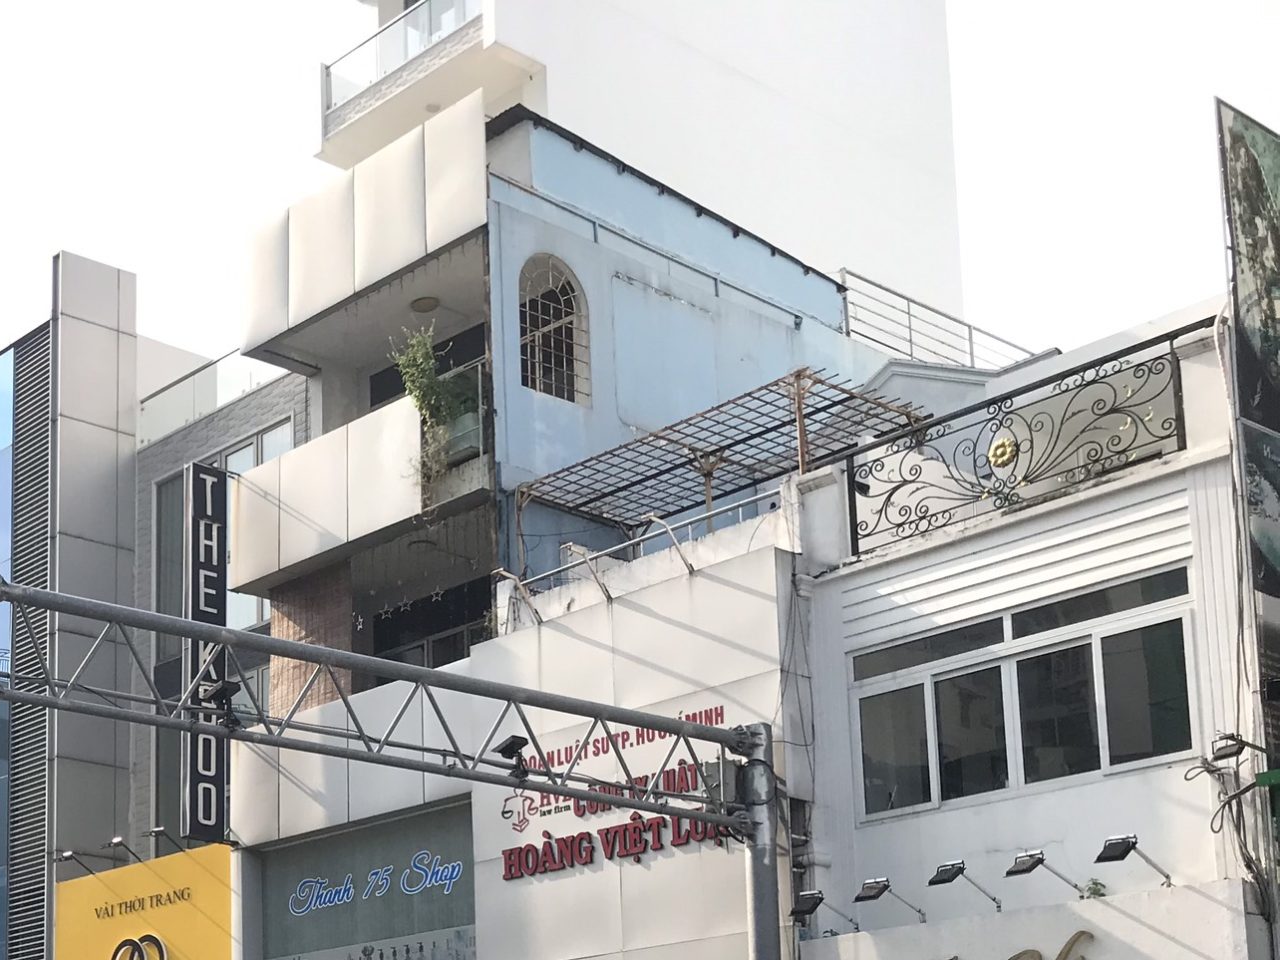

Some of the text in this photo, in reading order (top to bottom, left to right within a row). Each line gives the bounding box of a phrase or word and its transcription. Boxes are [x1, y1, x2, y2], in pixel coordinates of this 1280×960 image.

[198, 473, 218, 614] THE
[539, 805, 571, 818] law firm
[502, 830, 595, 881] HOÀNG
[597, 811, 667, 863] VIỆT
[94, 886, 191, 920] VẢI THỜI TRANG
[289, 850, 463, 916] Thanh 75 Shop
